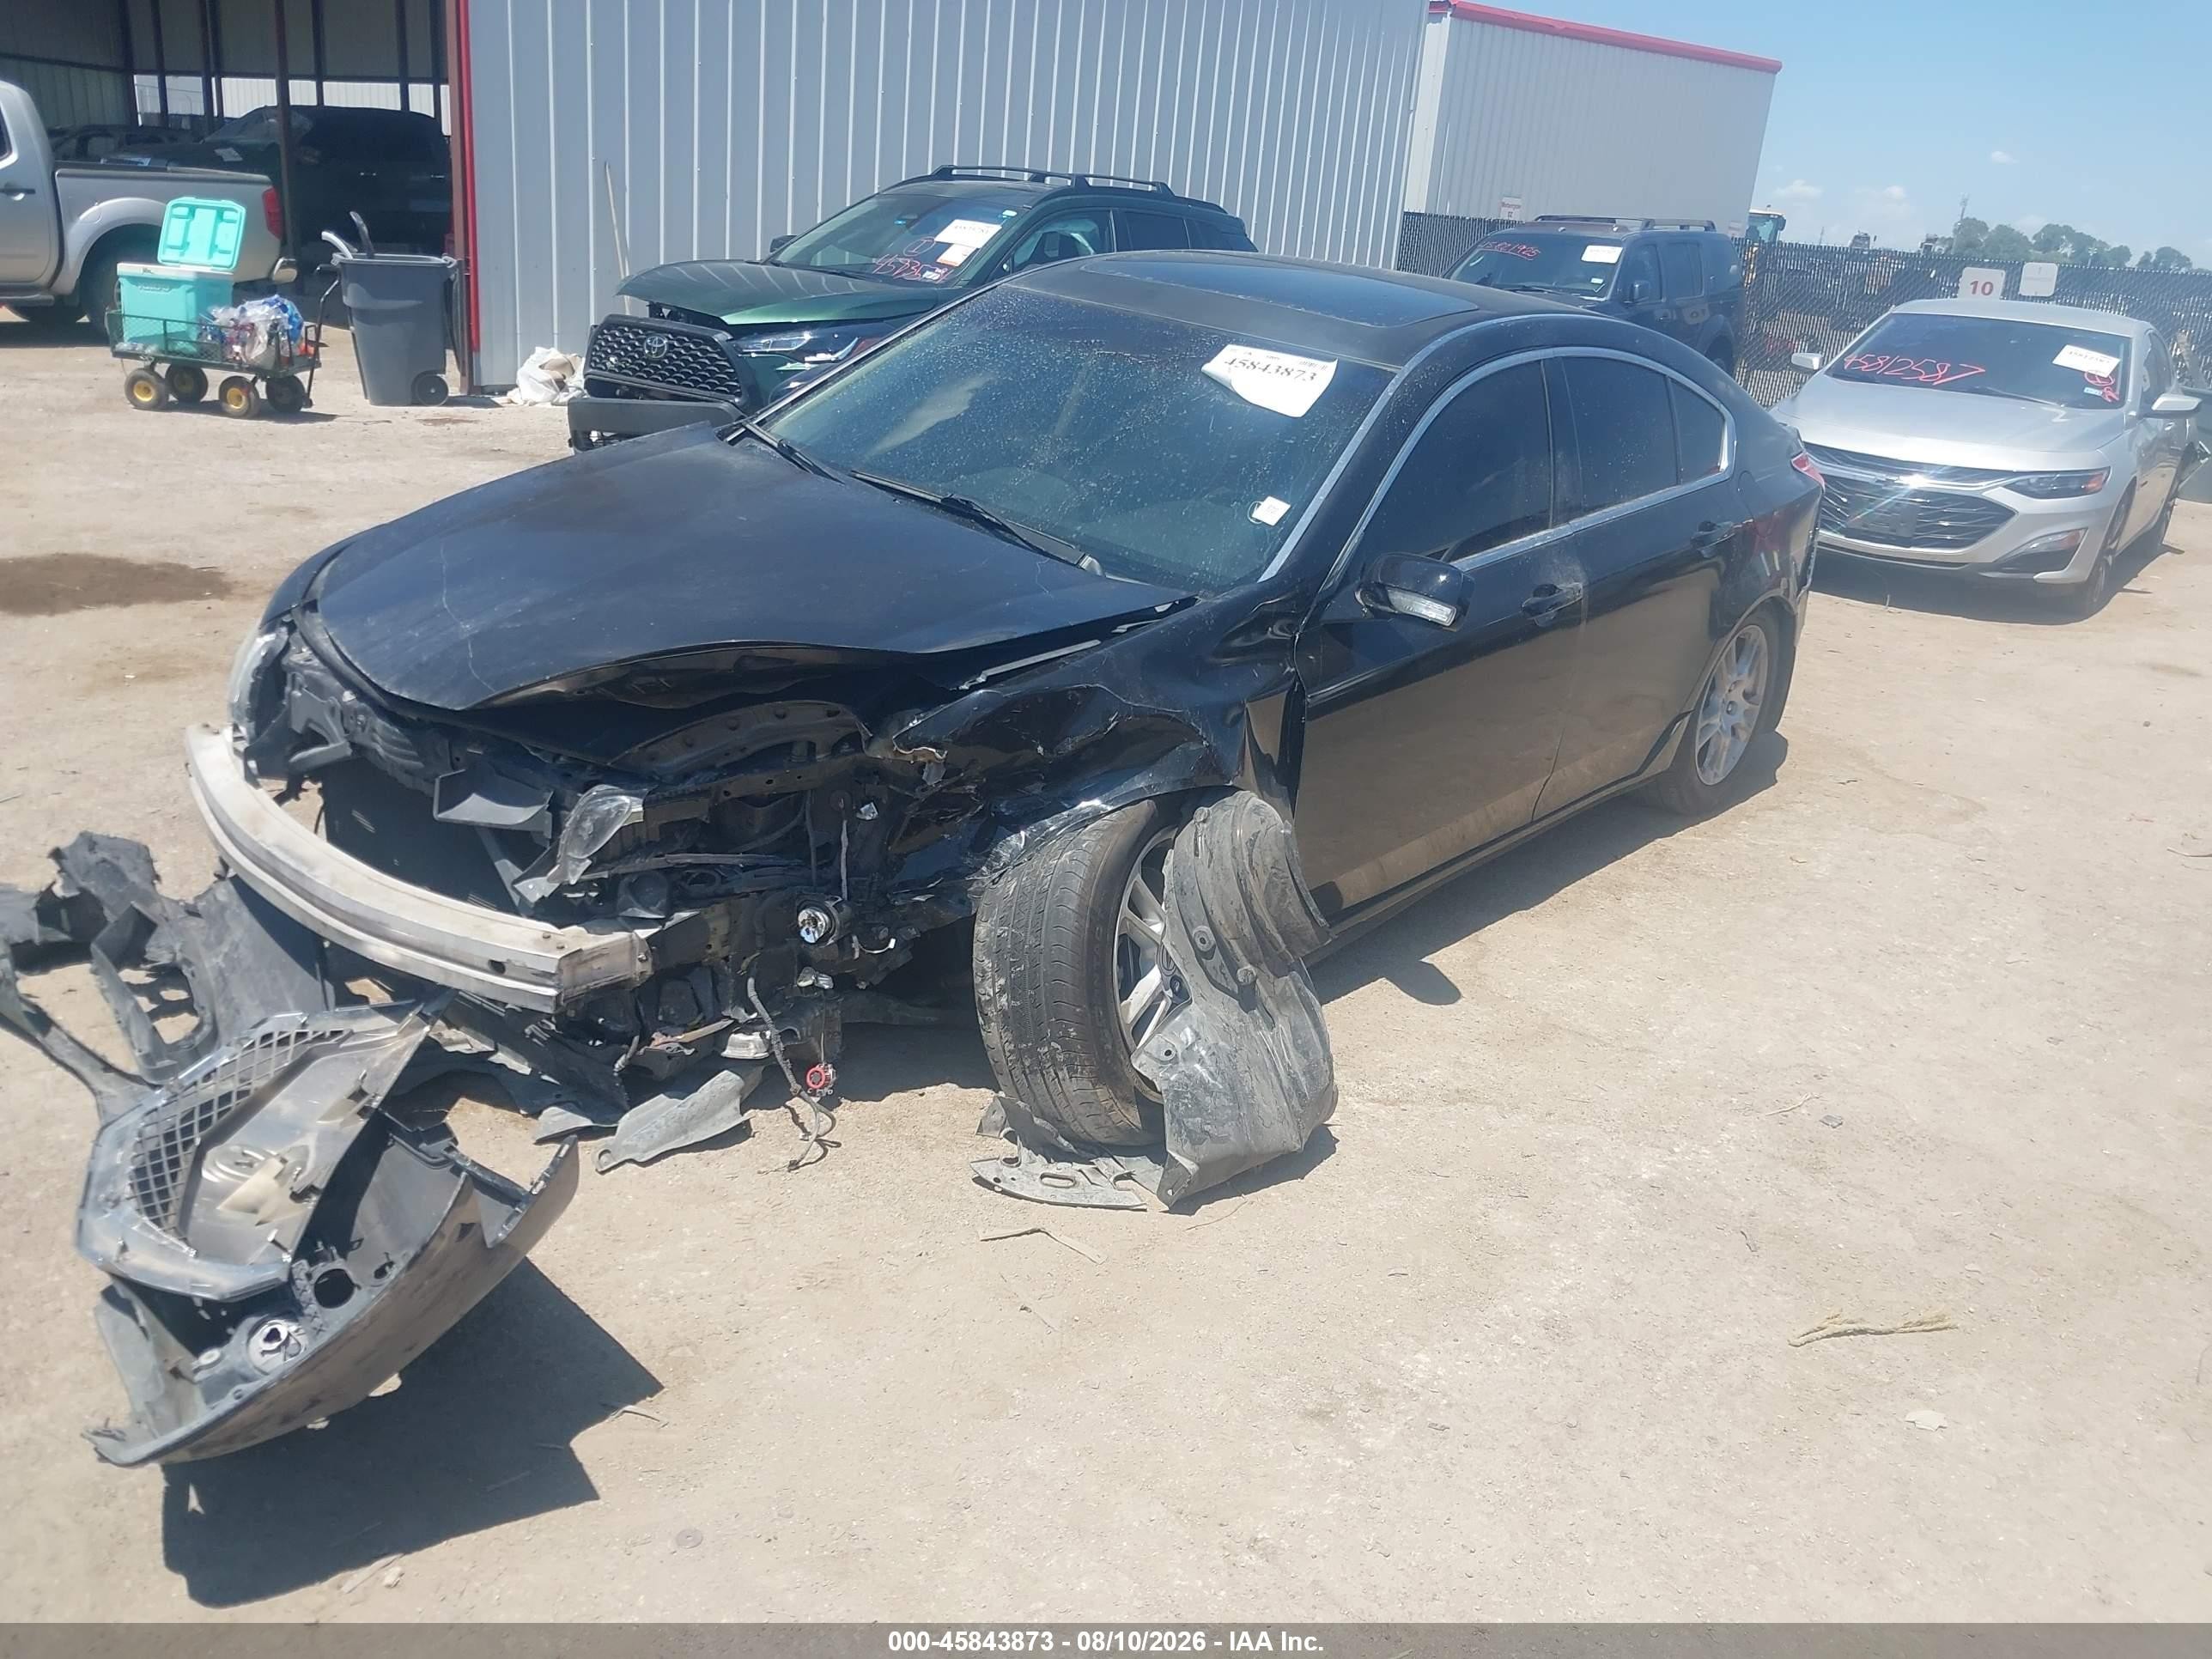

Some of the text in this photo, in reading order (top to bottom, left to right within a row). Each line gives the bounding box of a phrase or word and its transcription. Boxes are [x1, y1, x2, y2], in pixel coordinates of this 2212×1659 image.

[1970, 281, 1994, 295] 10
[1224, 358, 1317, 381] 45843873
[1844, 355, 1986, 386] 45812587
